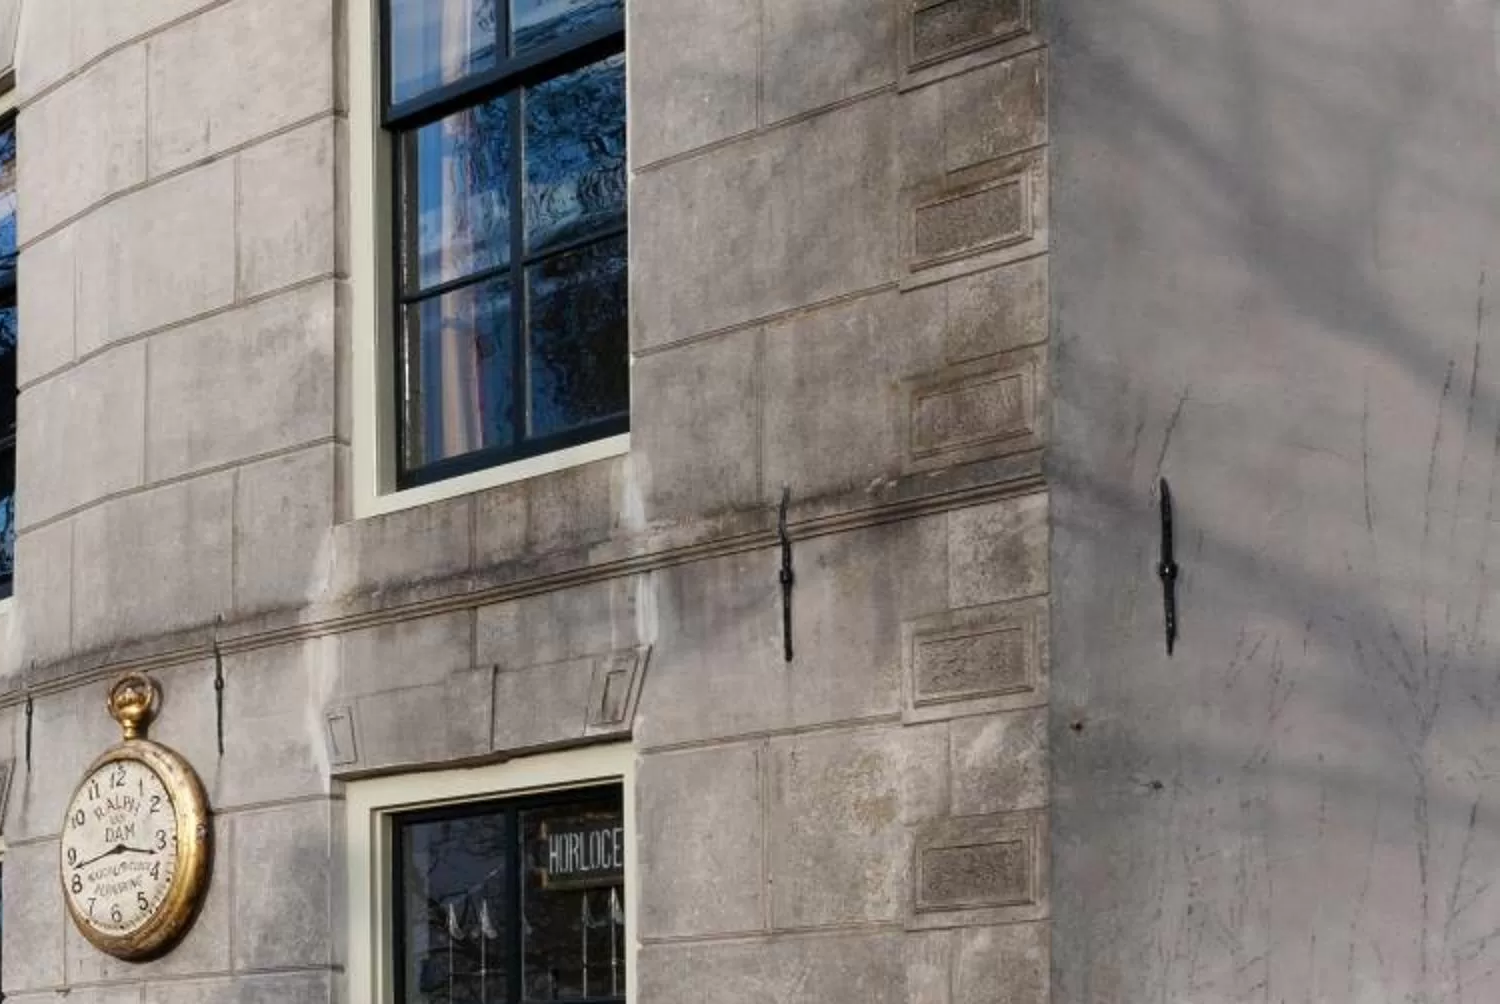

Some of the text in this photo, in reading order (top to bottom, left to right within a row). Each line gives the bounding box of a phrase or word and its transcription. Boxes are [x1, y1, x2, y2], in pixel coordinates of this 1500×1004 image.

[110, 769, 126, 789] 12
[88, 783, 100, 801] 11
[94, 795, 140, 818] RALPH
[150, 795, 161, 813] 2
[71, 809, 85, 829] 10
[105, 824, 135, 843] DAM
[156, 830, 167, 850] 3
[68, 848, 77, 866] 9
[149, 861, 161, 880] 4
[71, 874, 82, 894] 8
[88, 898, 96, 916] 7
[138, 892, 149, 911] 5
[111, 904, 122, 923] 6
